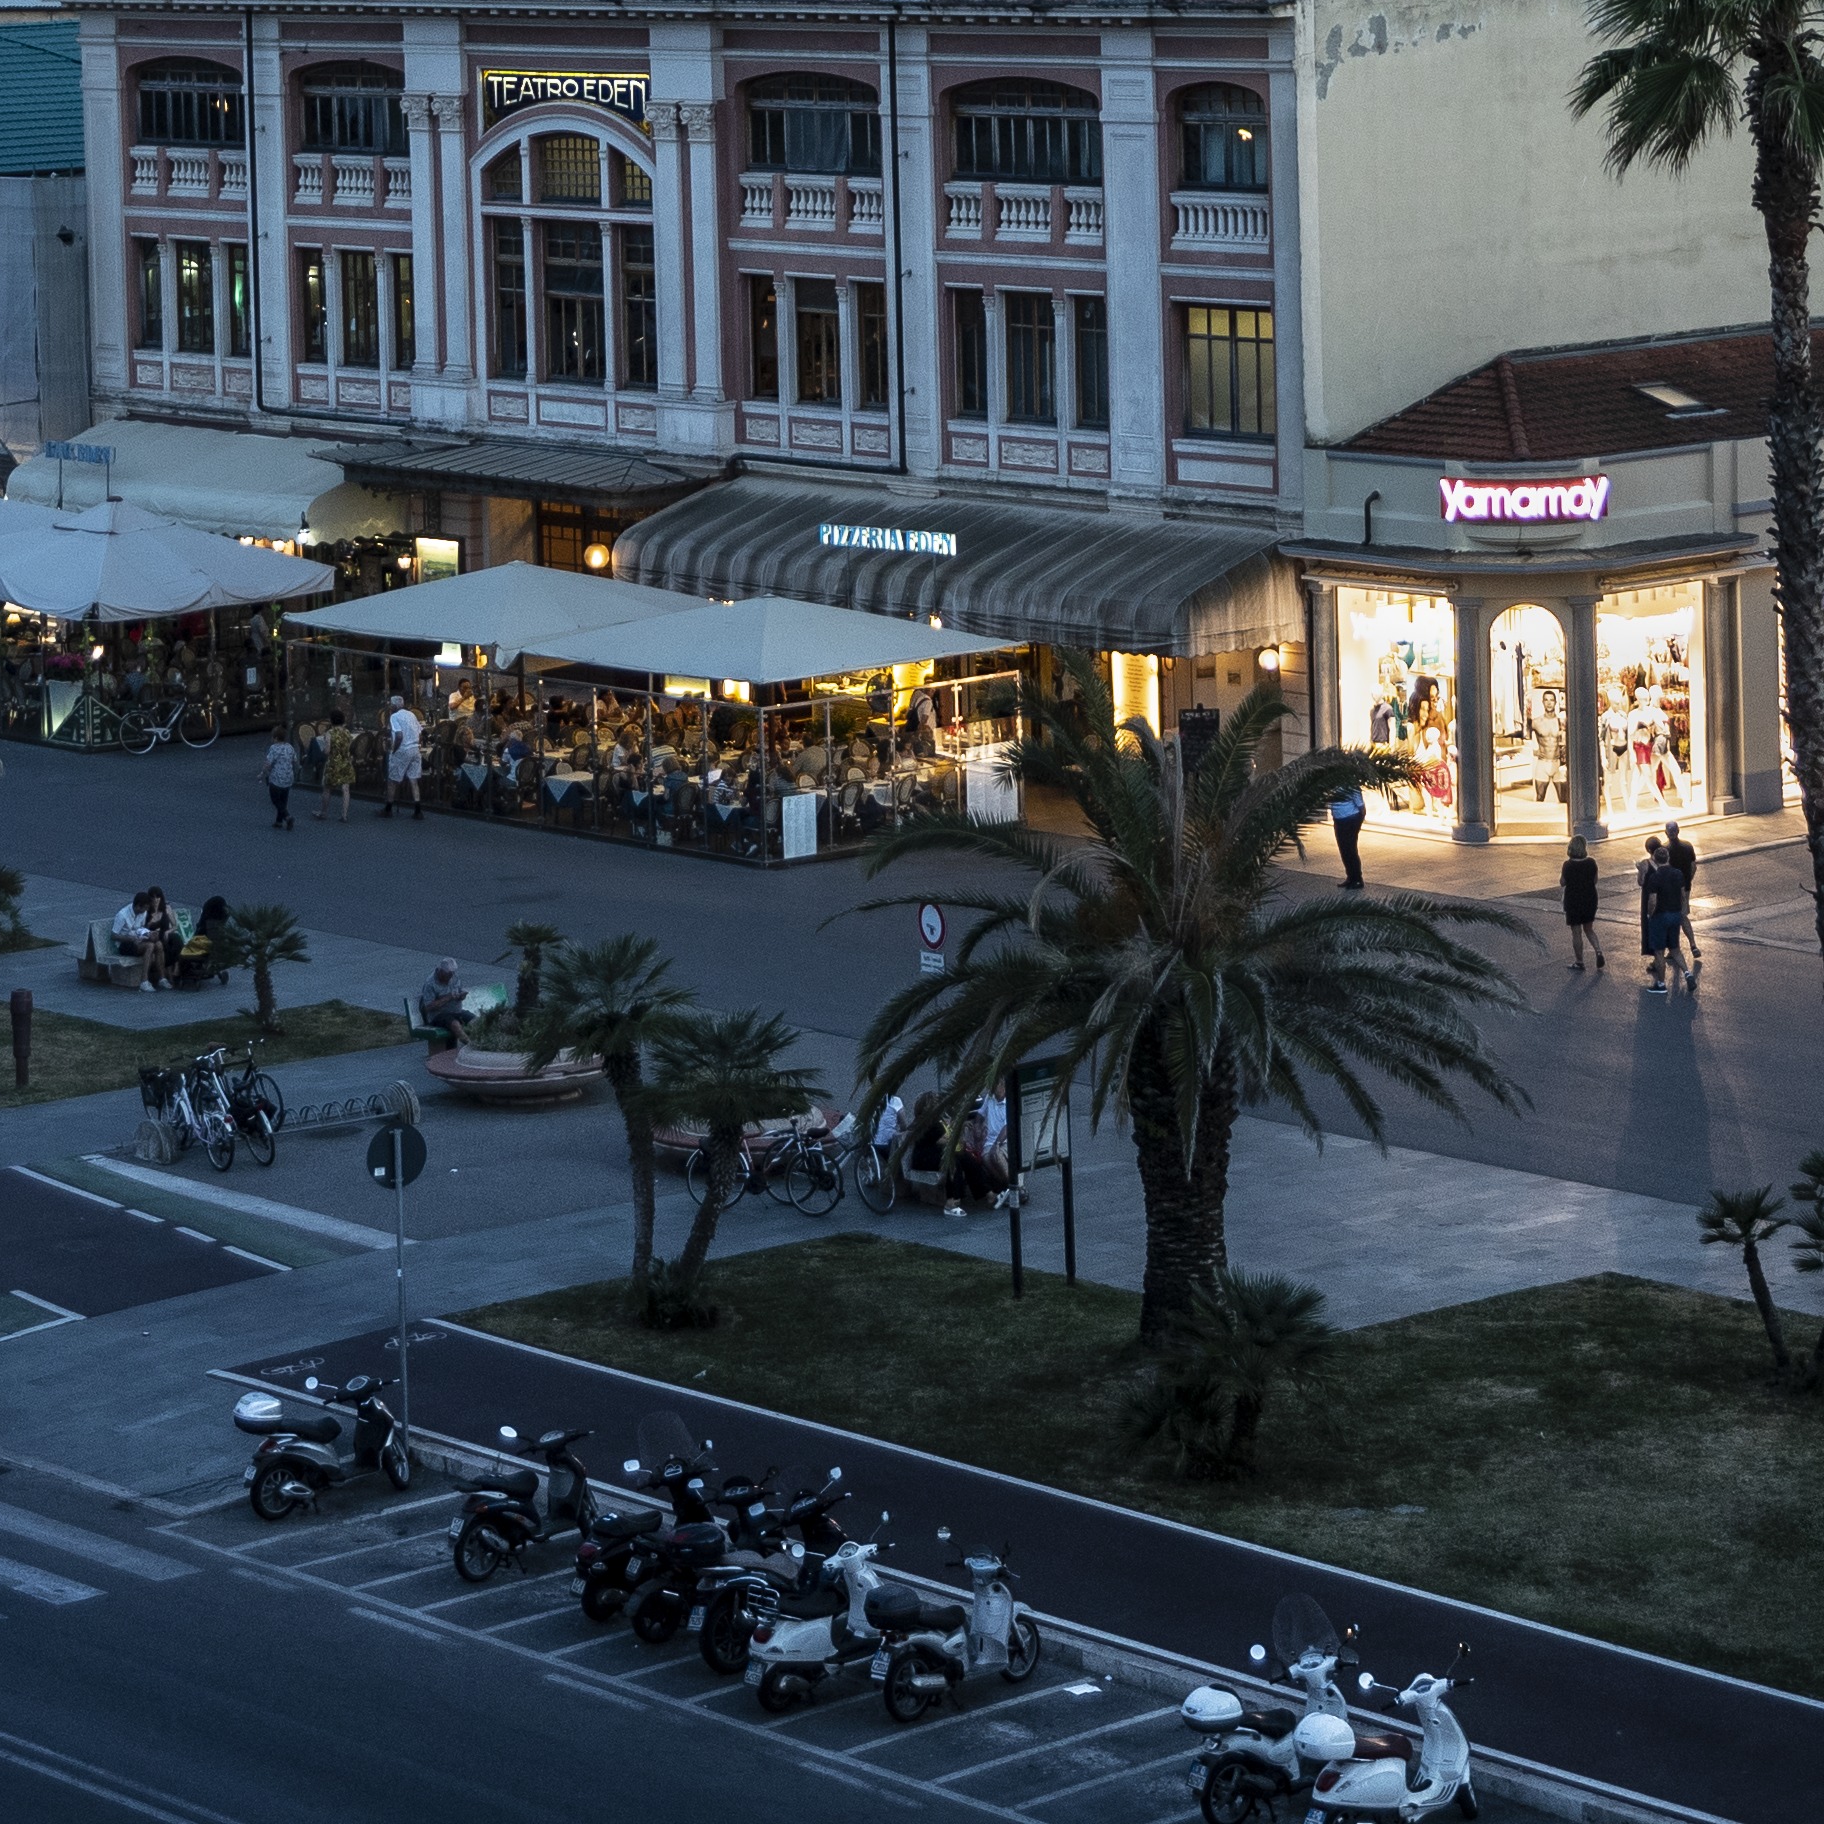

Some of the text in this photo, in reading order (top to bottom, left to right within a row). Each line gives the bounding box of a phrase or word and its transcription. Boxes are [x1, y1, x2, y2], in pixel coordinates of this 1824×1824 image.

[488, 76, 646, 113] TEATRO EDEN
[819, 523, 957, 557] PIZZERIA EDEN
